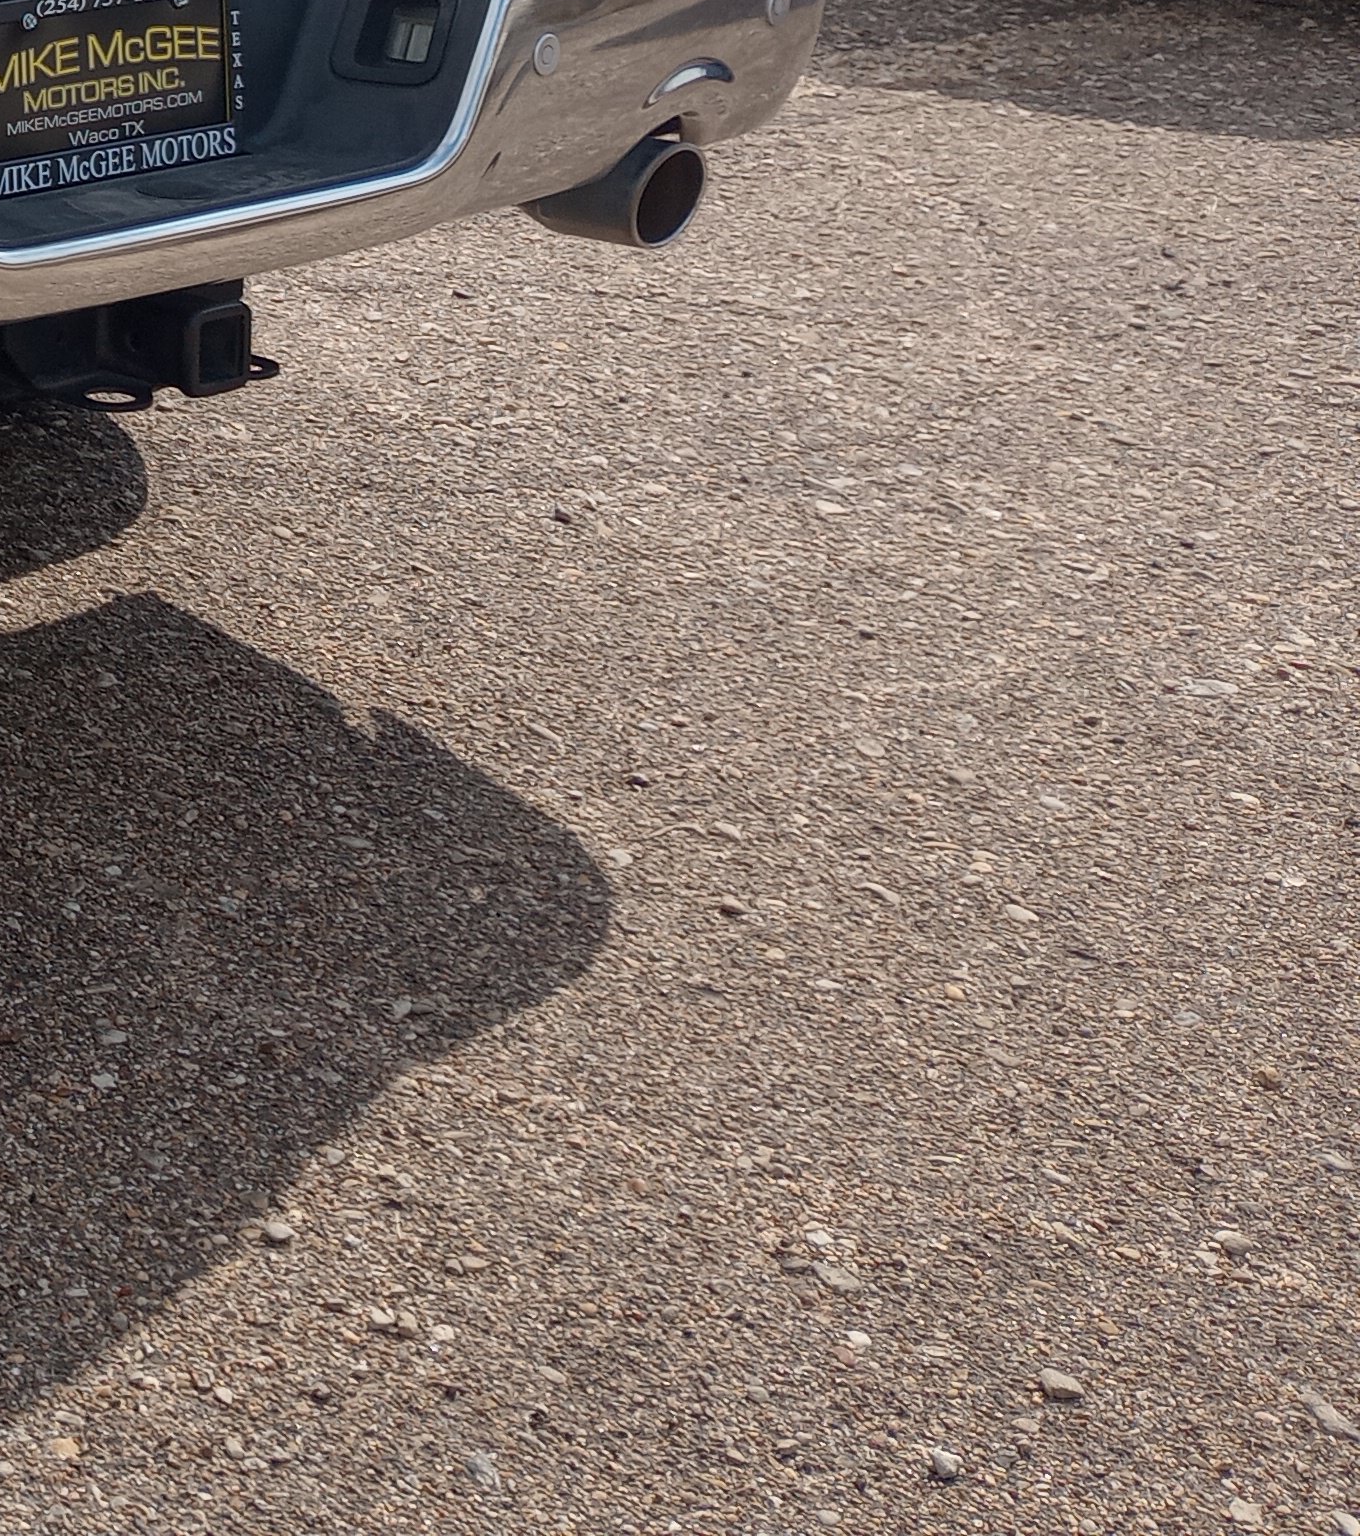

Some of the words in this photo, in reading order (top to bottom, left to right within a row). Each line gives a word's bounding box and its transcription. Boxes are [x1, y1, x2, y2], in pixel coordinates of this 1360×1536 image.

[87, 25, 222, 70] McGEE
[230, 10, 245, 112] TEXAS
[6, 90, 203, 137] MIKEMcGEEMOTORS.COM
[23, 71, 135, 114] MOTORS
[138, 66, 187, 95] INC.
[58, 145, 137, 183] McGEE
[141, 128, 237, 170] MOTORS
[68, 127, 119, 148] Waco
[121, 120, 145, 137] TX
